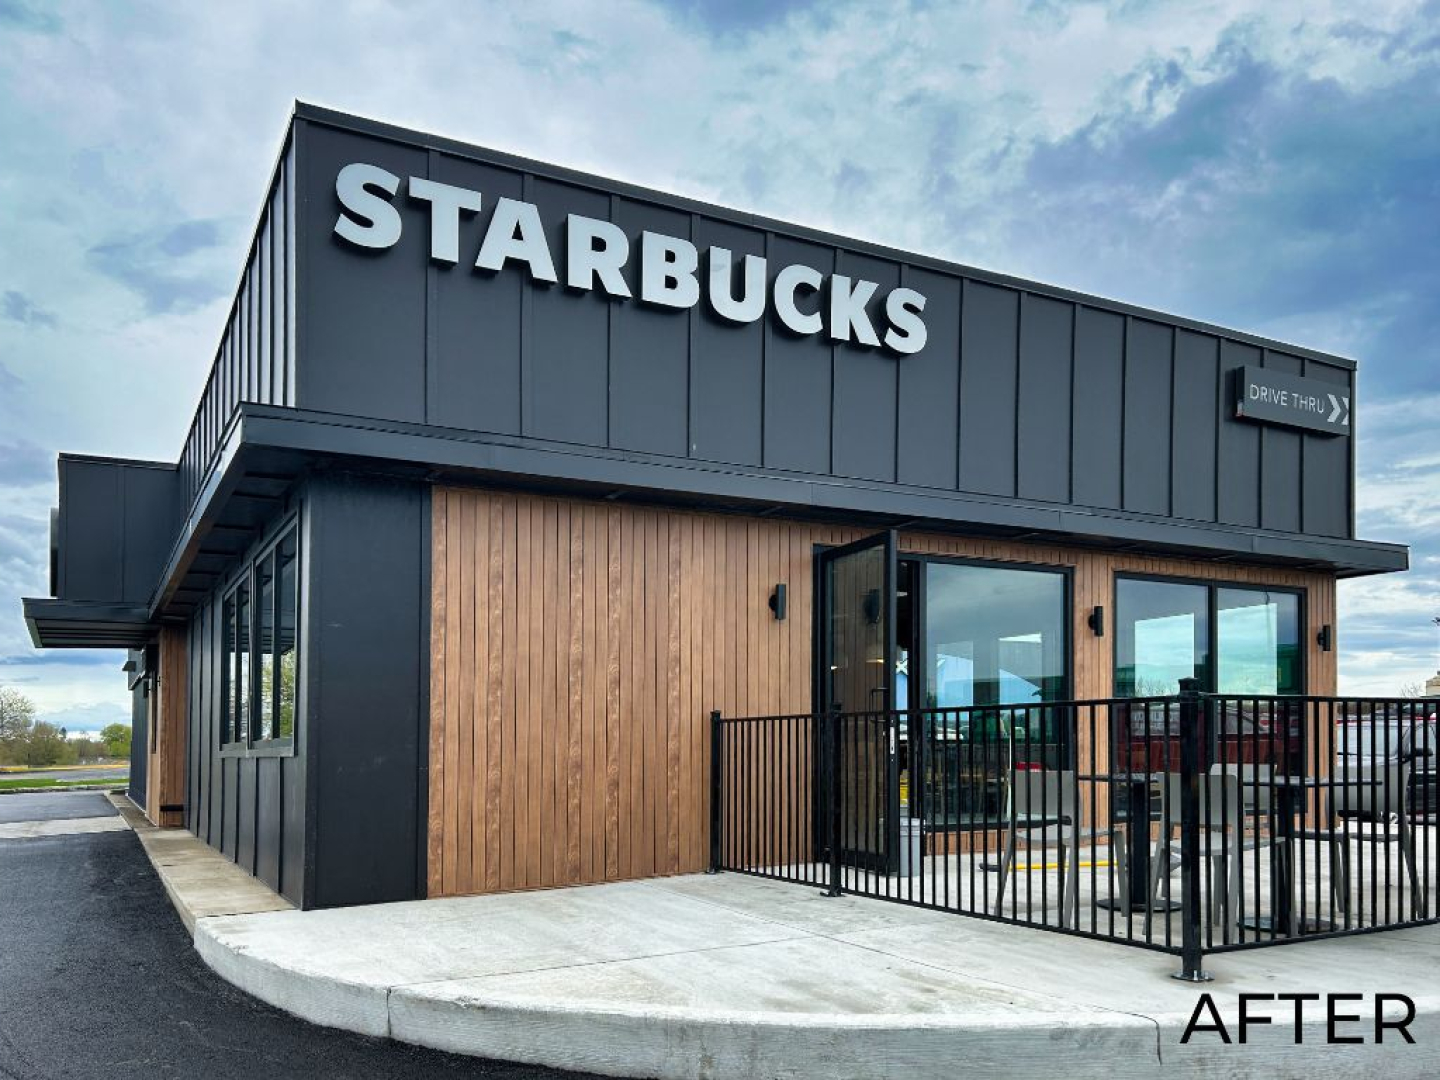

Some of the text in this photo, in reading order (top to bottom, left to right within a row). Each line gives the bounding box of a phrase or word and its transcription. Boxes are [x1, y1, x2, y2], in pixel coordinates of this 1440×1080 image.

[333, 162, 928, 355] STARBUCKS
[1249, 383, 1325, 415] DRIVE THRU
